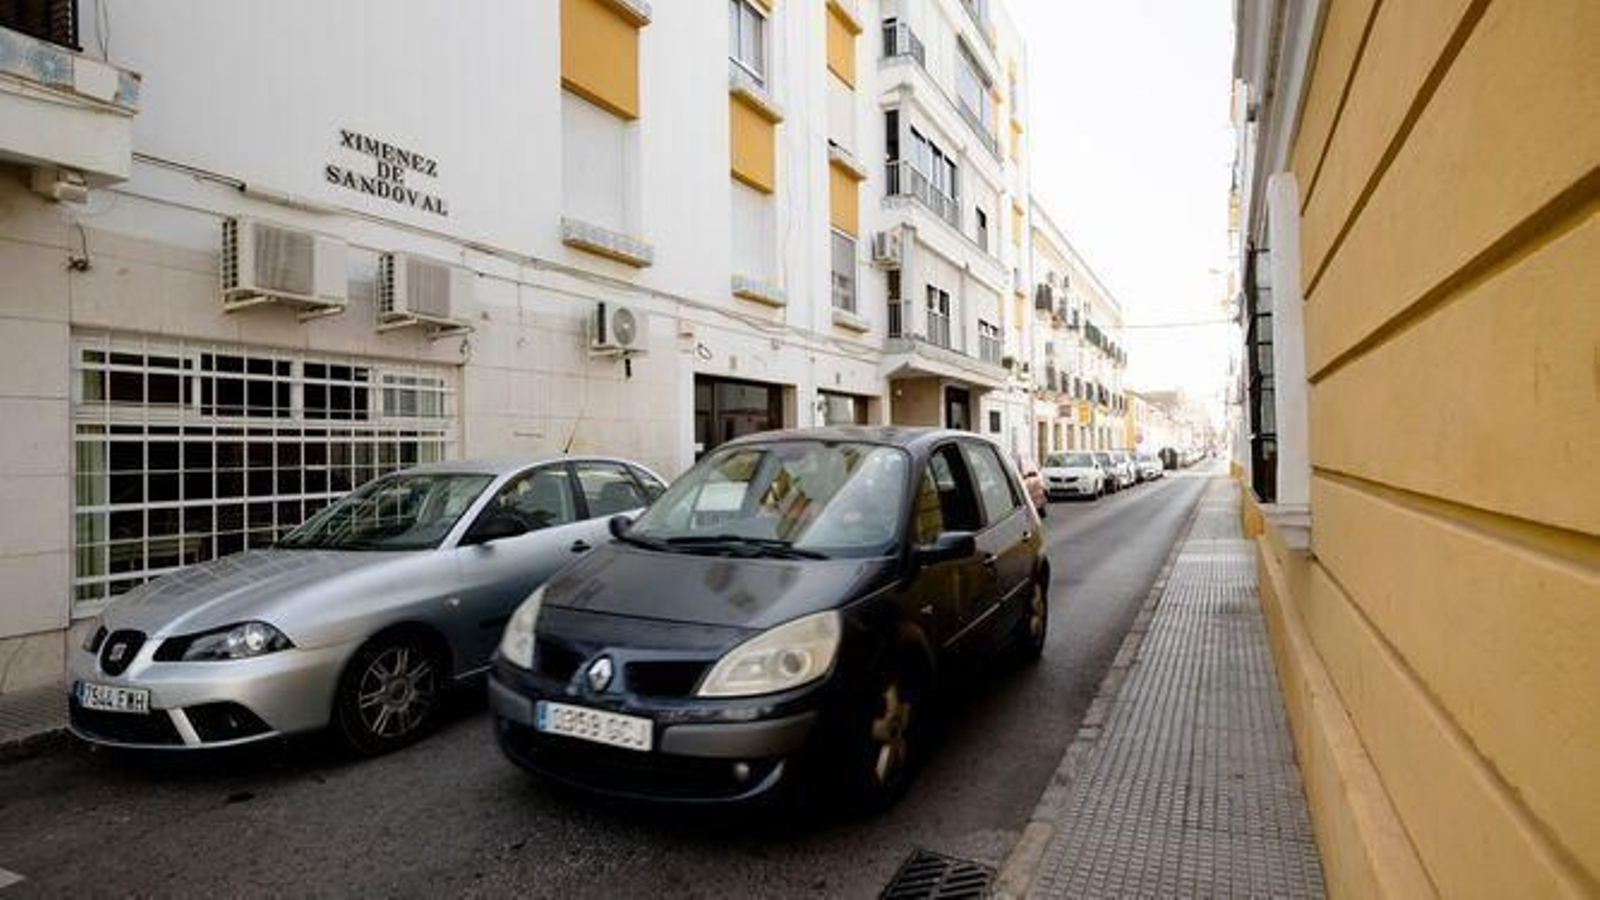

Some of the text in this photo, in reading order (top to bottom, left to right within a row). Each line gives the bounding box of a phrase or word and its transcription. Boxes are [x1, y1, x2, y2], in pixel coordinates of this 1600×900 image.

[340, 129, 438, 178] XIMENEZ
[378, 160, 404, 184] DE
[325, 164, 448, 216] SANDOVAL
